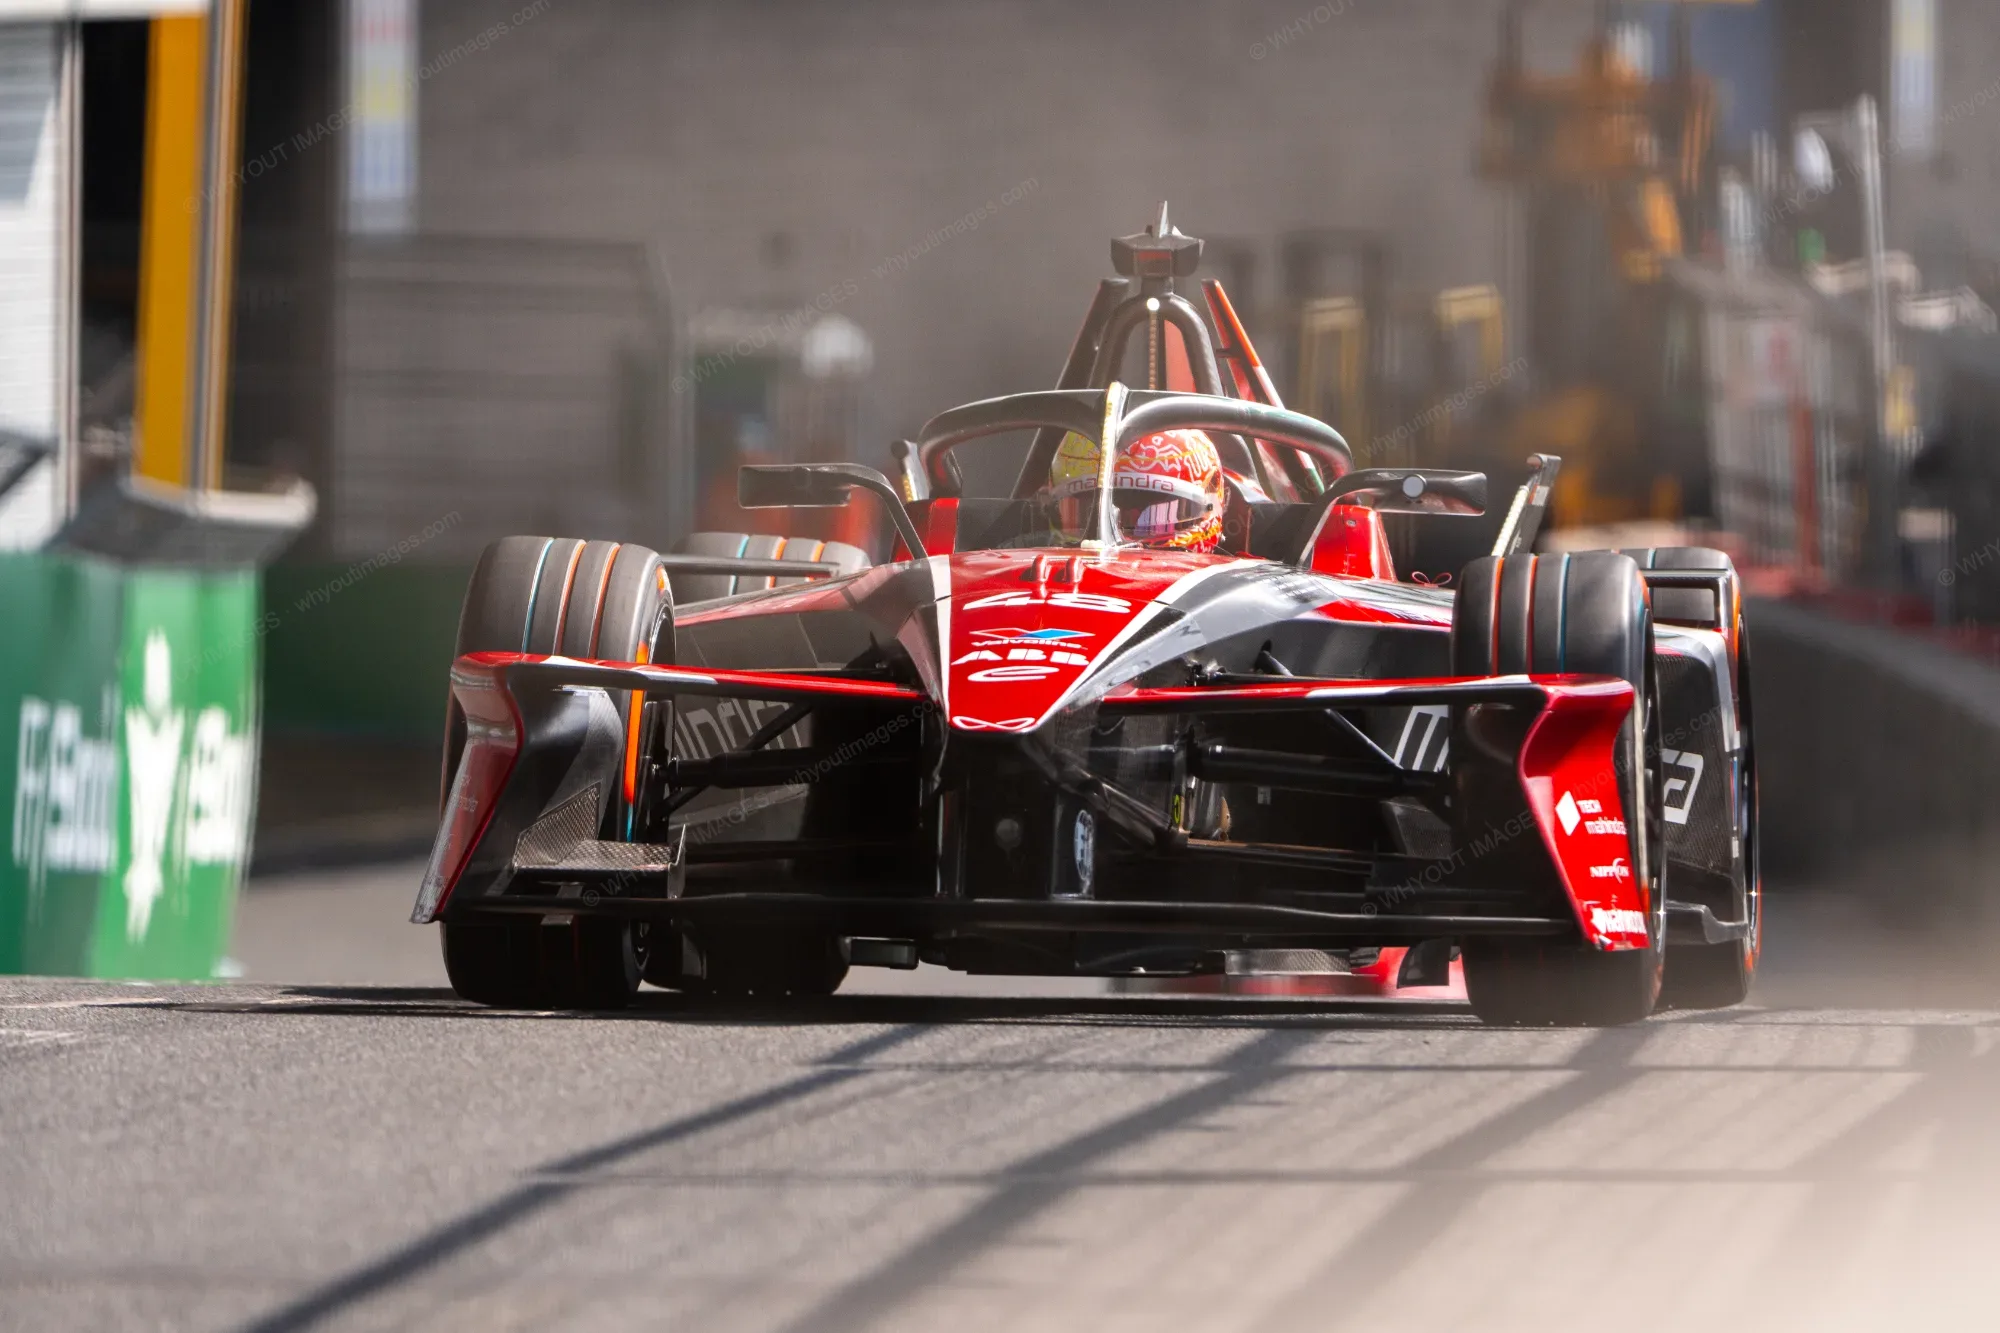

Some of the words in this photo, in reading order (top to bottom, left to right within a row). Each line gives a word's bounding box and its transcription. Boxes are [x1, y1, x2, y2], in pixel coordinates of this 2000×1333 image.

[1067, 473, 1174, 493] maindra
[962, 590, 1132, 613] 48
[951, 648, 1090, 666] ABB
